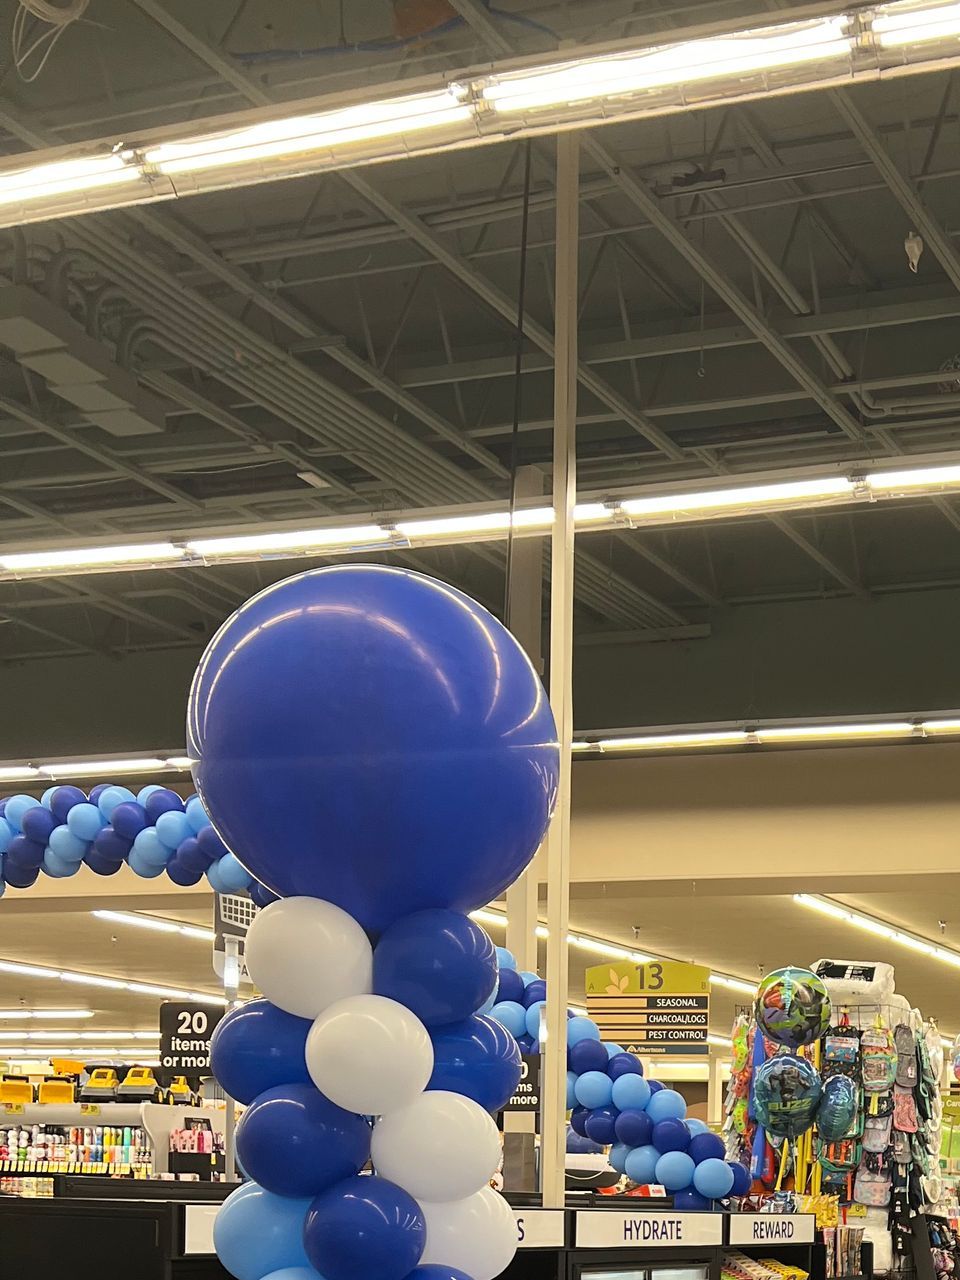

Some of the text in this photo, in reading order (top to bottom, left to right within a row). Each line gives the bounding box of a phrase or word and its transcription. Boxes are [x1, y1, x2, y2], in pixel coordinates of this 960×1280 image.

[635, 963, 664, 990] 13
[656, 998, 699, 1007] SEASONAL
[177, 1011, 208, 1034] 20
[648, 1014, 706, 1024] CHARCOAL/LOGS
[648, 1030, 706, 1039] PEST CONTROL
[171, 1036, 212, 1051] items
[163, 1056, 179, 1068] or
[509, 1095, 538, 1105] more
[624, 1220, 682, 1240] HYDRATE
[753, 1221, 794, 1239] REWARD
